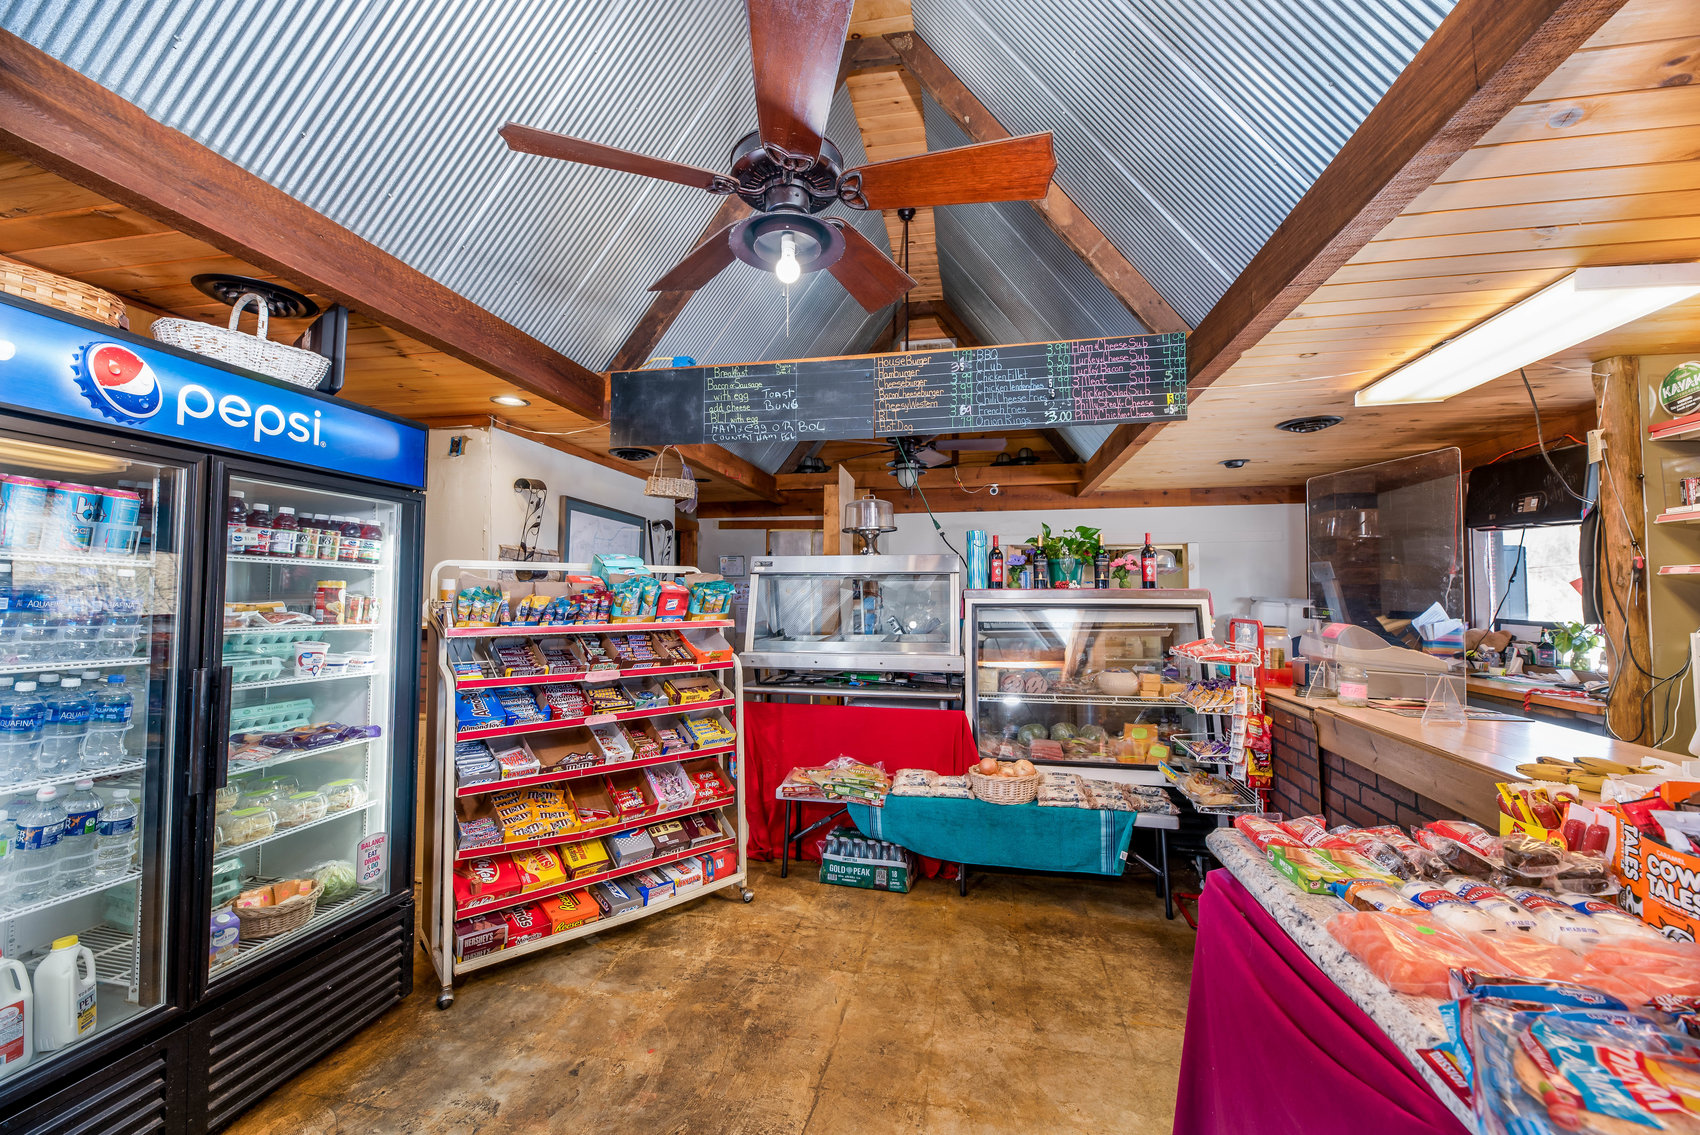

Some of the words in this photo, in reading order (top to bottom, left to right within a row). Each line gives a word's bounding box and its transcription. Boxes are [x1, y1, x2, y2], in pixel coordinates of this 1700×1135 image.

[1071, 341, 1093, 353] Ham
[1097, 338, 1128, 351] Cheese
[1128, 336, 1149, 348] Sub
[976, 348, 999, 360] BBQ
[1071, 352, 1101, 368] Turkey
[1102, 351, 1129, 363] Cheese
[1129, 348, 1150, 361] Sub
[714, 366, 748, 378] Breakfast
[877, 366, 920, 380] Hamburger
[975, 370, 1007, 382] Chicken
[1007, 368, 1028, 380] Fillet
[1071, 364, 1099, 380] Turkey
[1100, 362, 1124, 374] Bacon
[1129, 360, 1151, 373] Sub
[707, 378, 728, 390] Bacon
[734, 378, 762, 390] Sausage
[878, 379, 927, 390] Cheeseburger
[975, 381, 1009, 393] Chicken
[1071, 376, 1080, 388] 3
[1081, 374, 1108, 386] Meat
[1129, 372, 1151, 385] Sub
[713, 390, 731, 401] with
[733, 392, 749, 402] egg
[975, 391, 996, 404] Chili
[996, 391, 1027, 404] Cheese
[1028, 390, 1047, 402] Fries
[1072, 386, 1106, 399] Chicken
[1106, 384, 1128, 397] Salad
[1128, 383, 1151, 396] Sub
[709, 403, 723, 413] add
[726, 401, 751, 412] cheese
[978, 404, 1005, 416] French
[1006, 403, 1027, 414] Fries
[1074, 397, 1097, 411] Philly
[1097, 396, 1121, 409] Steak
[1124, 397, 1155, 408] Cheese
[176, 384, 322, 446] pepsi
[710, 412, 727, 423] BLT
[730, 413, 744, 423] with
[746, 416, 758, 425] egg
[878, 408, 899, 421] BLT
[975, 415, 1003, 426] Onion
[1004, 413, 1031, 427] Rings
[1074, 408, 1098, 424] Philly
[461, 722, 489, 732] Almond
[702, 736, 733, 746] Butterfinger
[507, 768, 535, 778] PAYDAY
[361, 836, 385, 850] BALANCE
[367, 849, 377, 858] EAT
[1624, 823, 1639, 882] TALES
[1656, 850, 1686, 866] CARAMEL
[364, 855, 380, 866] DRINK
[371, 861, 379, 869] DO
[829, 863, 846, 873] GOLD
[853, 867, 870, 876] PEAK
[891, 870, 898, 878] 18
[1646, 853, 1700, 892] COW
[1646, 873, 1700, 917] TALES
[511, 907, 533, 928] unds
[464, 932, 494, 948] HERSHEY'S
[516, 932, 543, 946] Mounds
[79, 994, 94, 1010] PET
